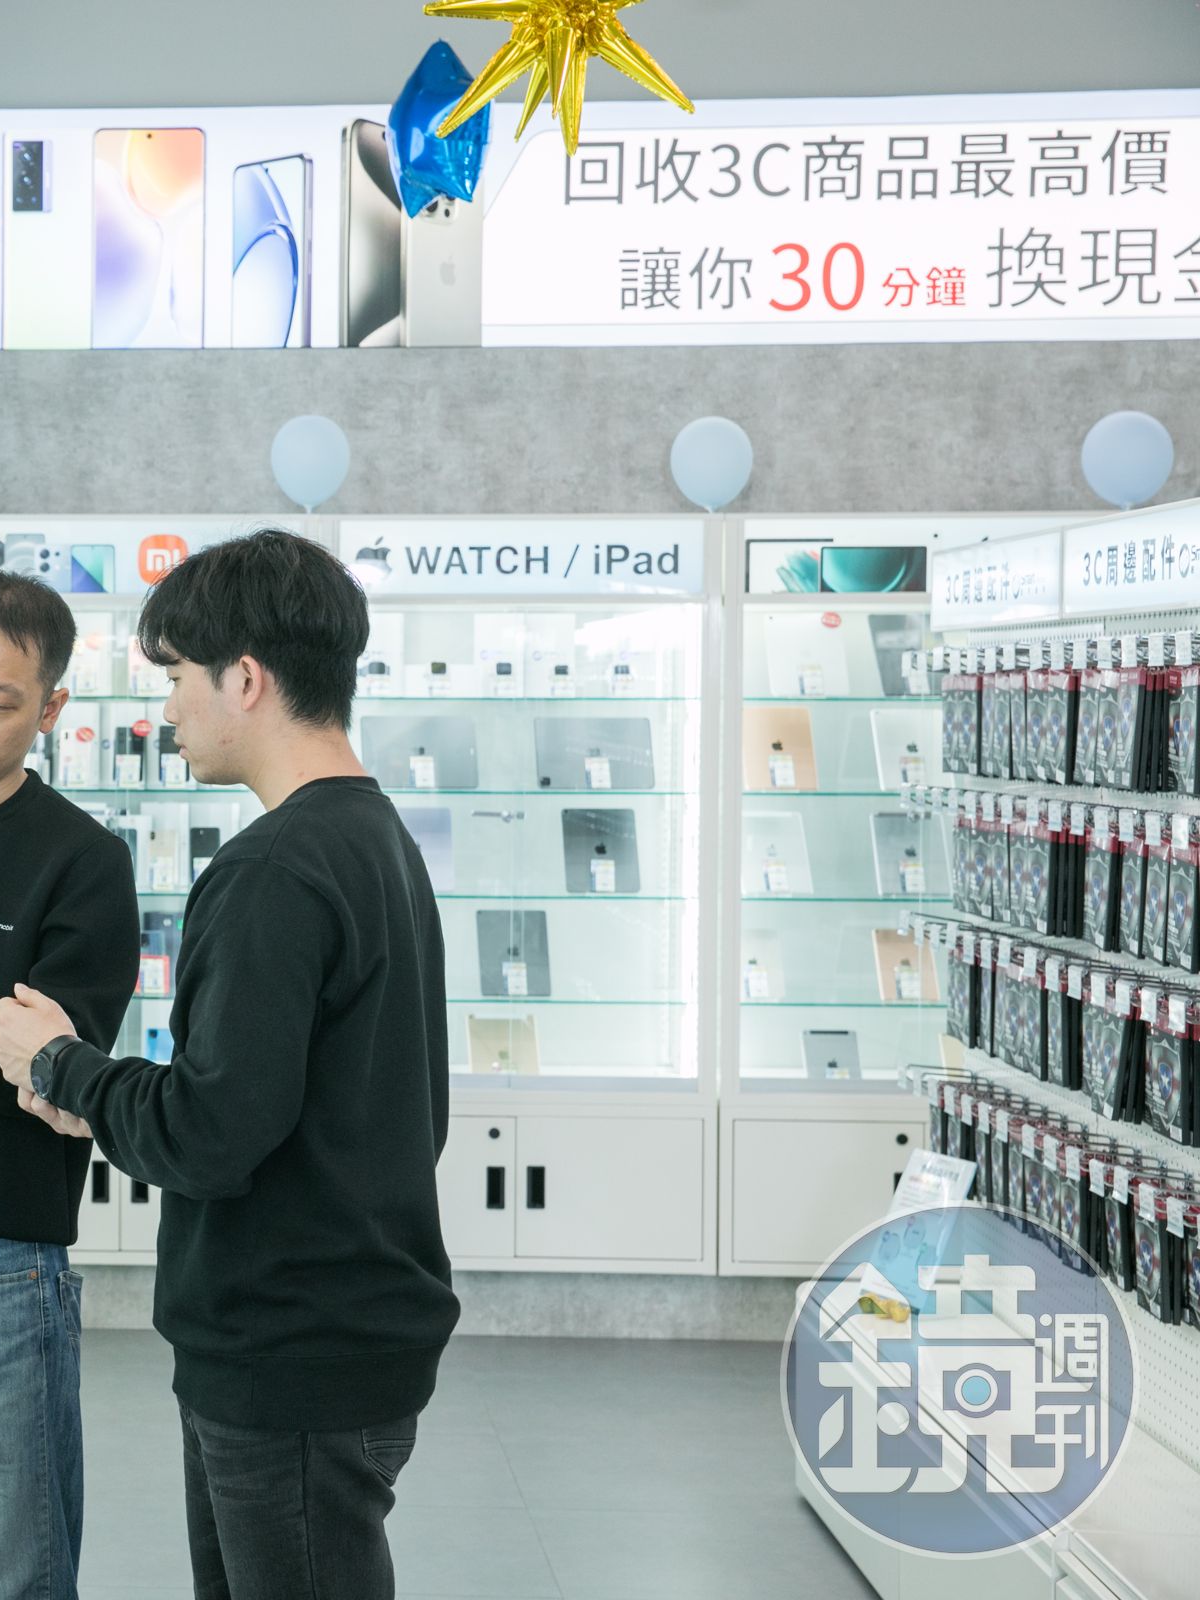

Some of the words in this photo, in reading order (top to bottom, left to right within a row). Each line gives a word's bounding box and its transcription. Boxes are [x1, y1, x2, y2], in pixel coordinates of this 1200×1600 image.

[562, 128, 1173, 206] 回收3C商品最高價
[405, 545, 550, 575] WATCH
[593, 544, 680, 575] iPad
[1082, 534, 1176, 588] 3C周邊配件
